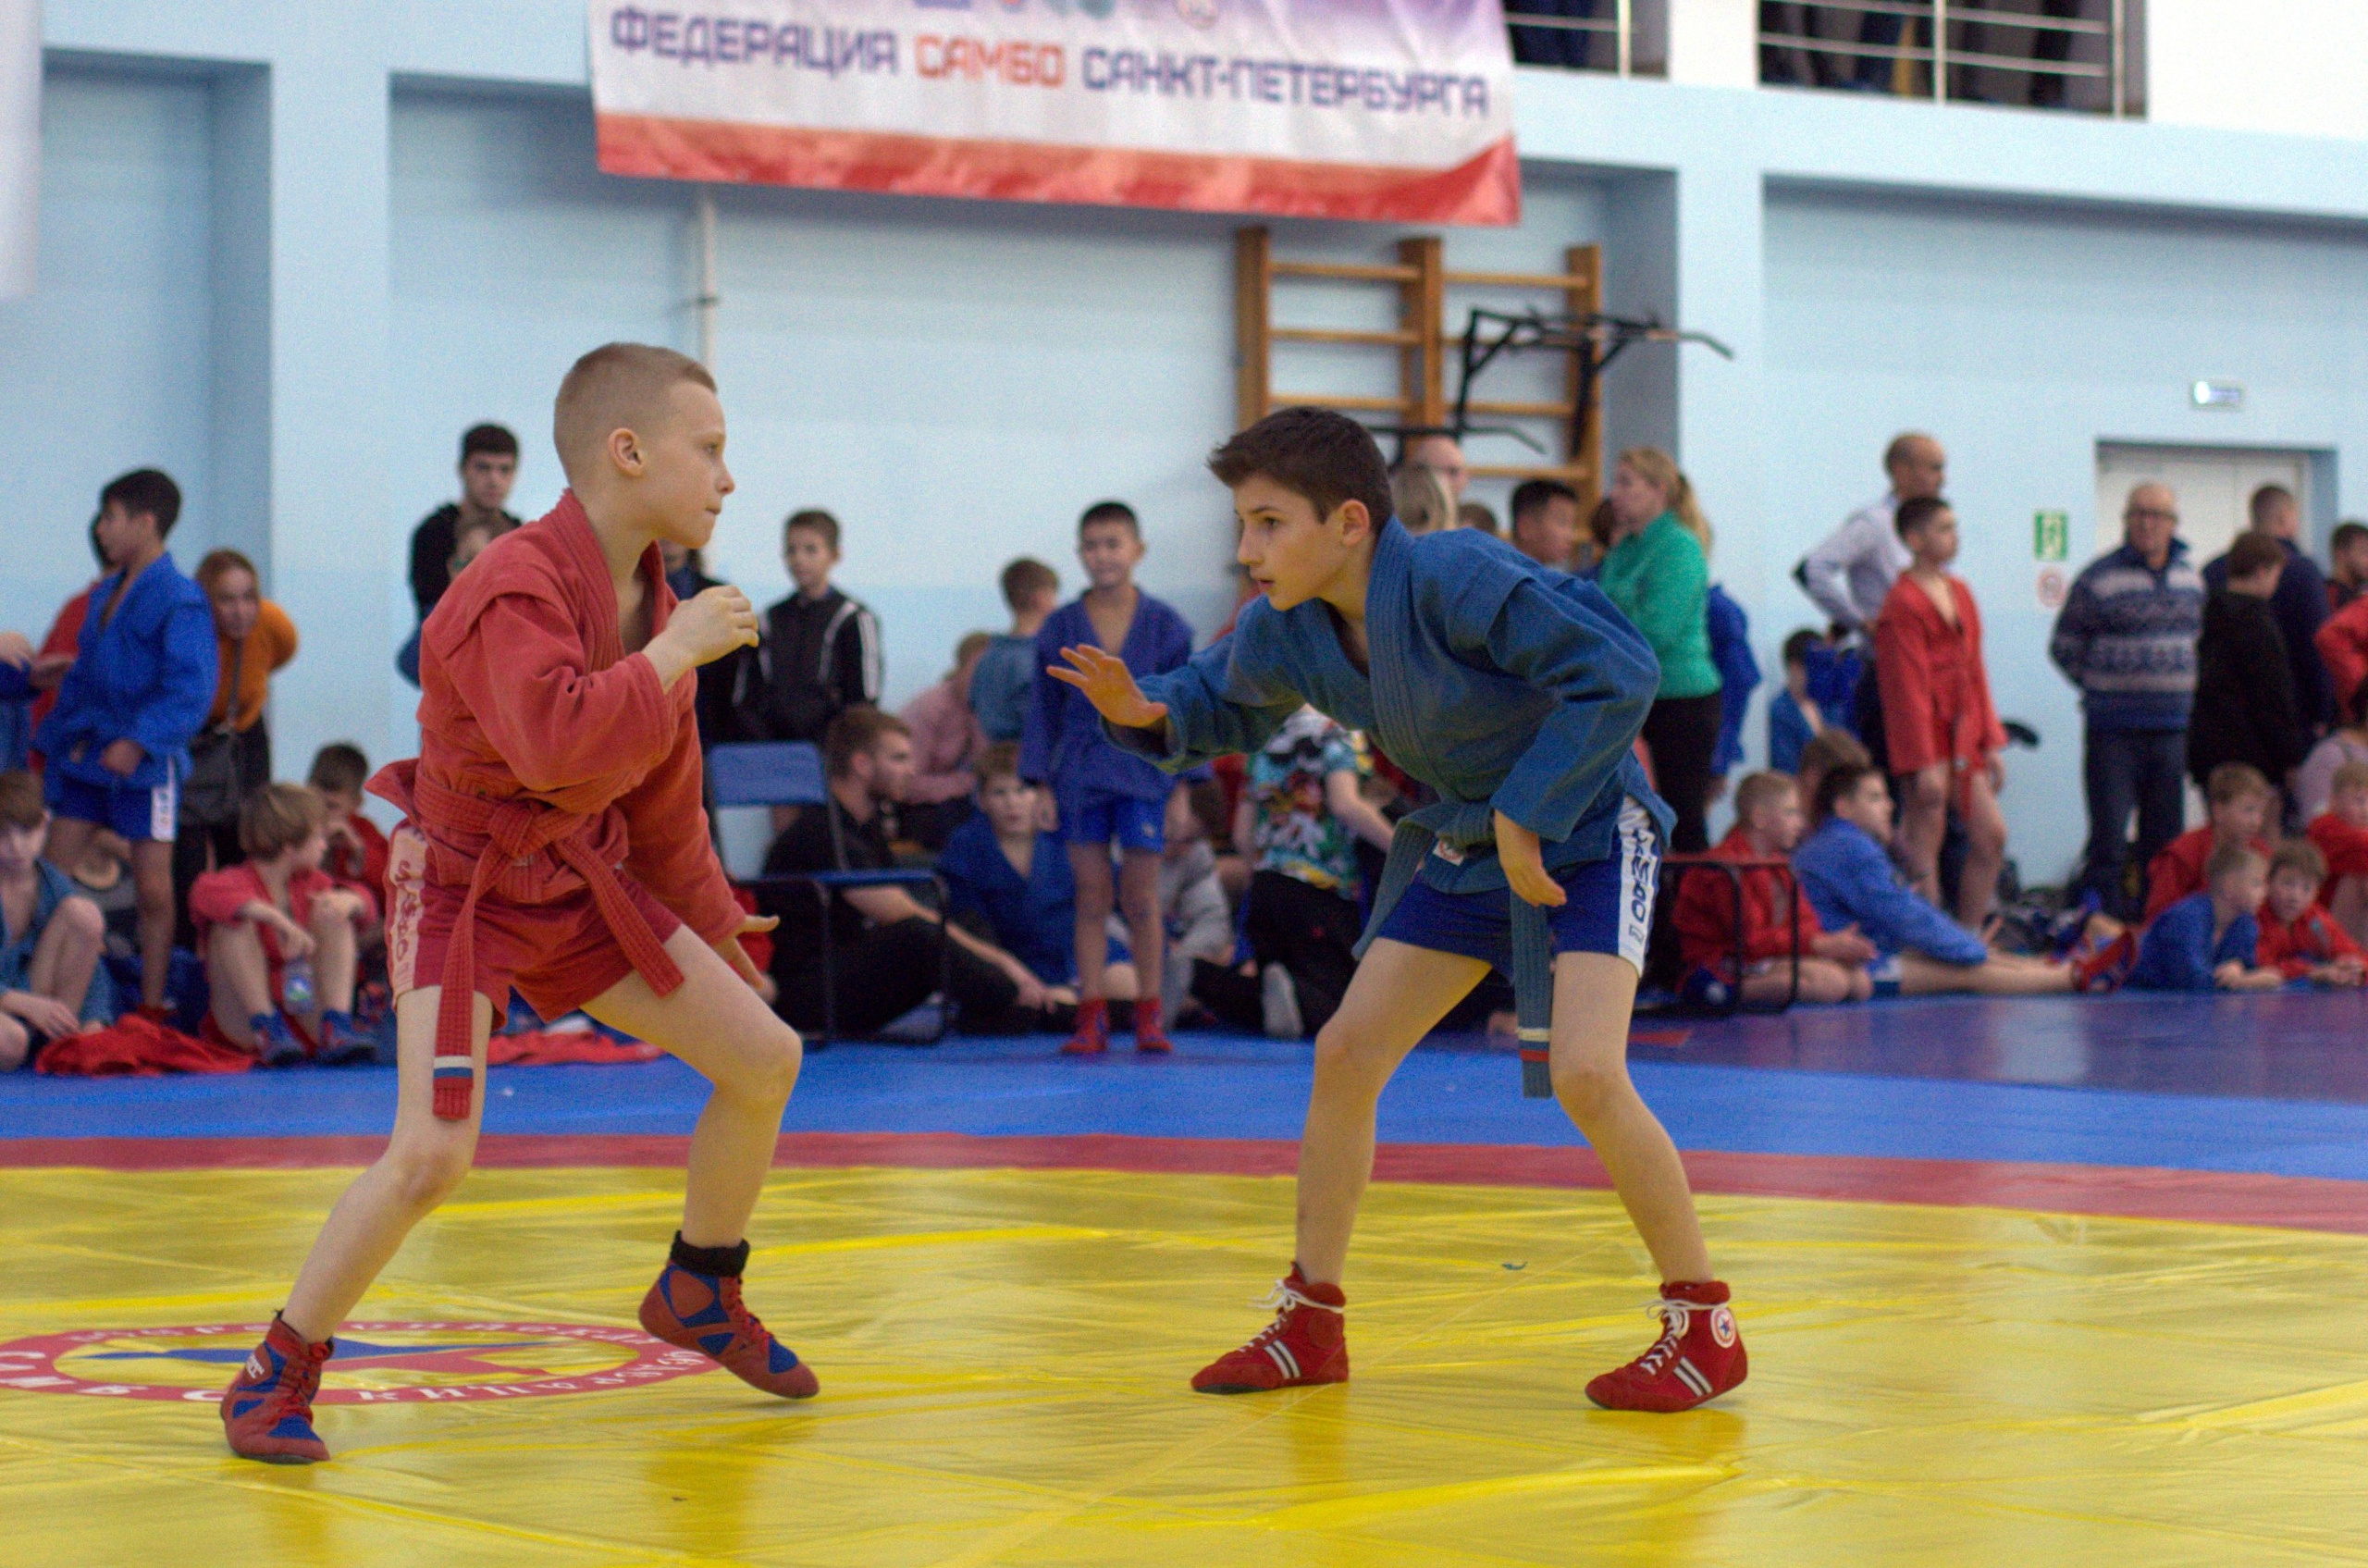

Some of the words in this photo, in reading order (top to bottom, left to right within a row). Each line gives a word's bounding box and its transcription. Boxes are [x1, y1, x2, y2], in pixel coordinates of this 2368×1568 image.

[610, 5, 900, 79] ФЕДЕРАЦИЯ
[914, 32, 1065, 88] САМБО
[1080, 45, 1489, 117] САНКТ-ПЕТЕРБУРГА
